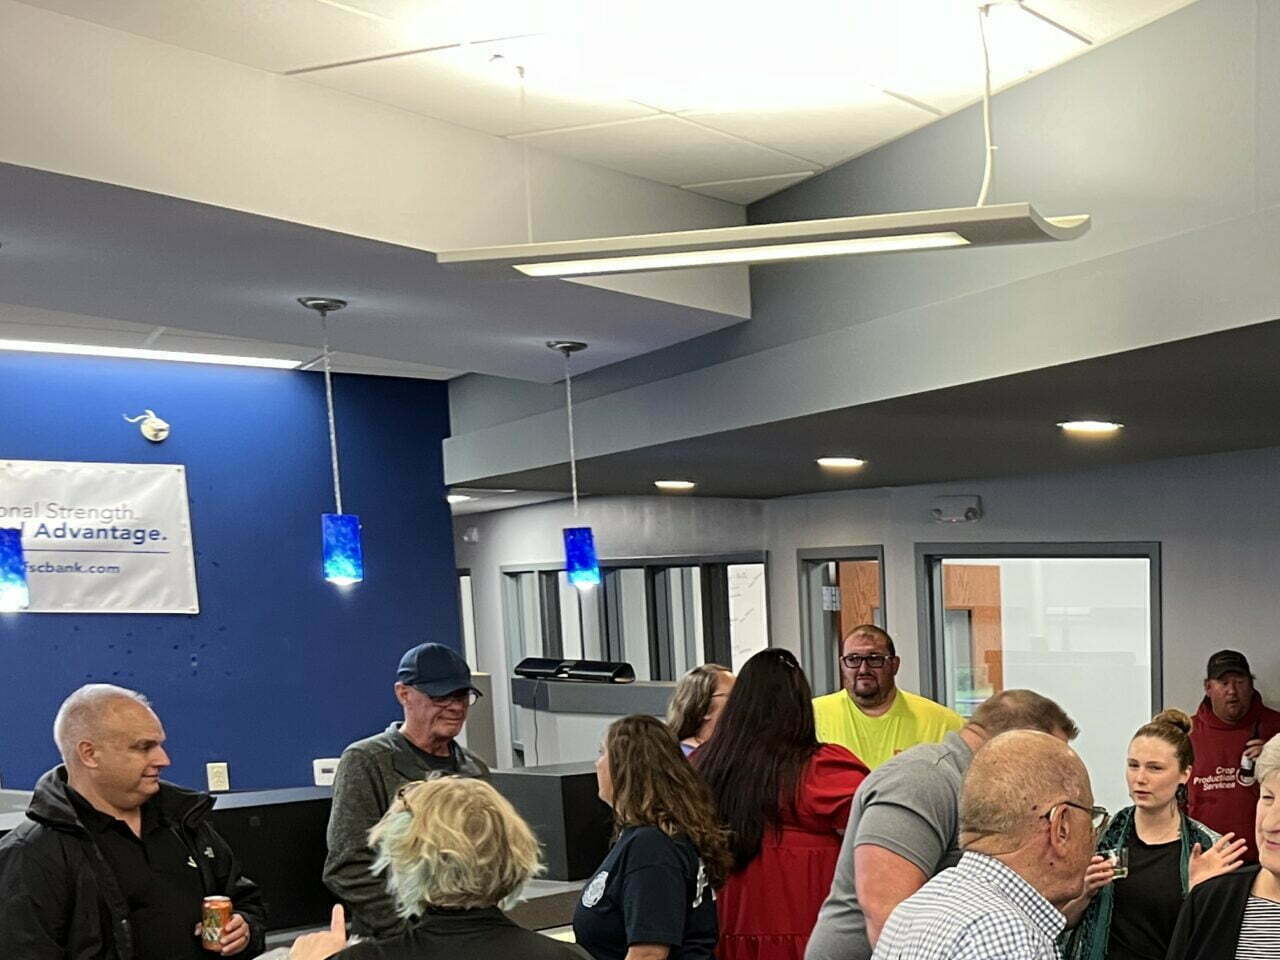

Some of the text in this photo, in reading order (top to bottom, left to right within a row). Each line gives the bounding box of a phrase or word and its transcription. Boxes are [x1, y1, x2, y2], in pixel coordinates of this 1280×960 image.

[34, 522, 168, 544] Advantage.
[1215, 766, 1235, 775] Crop
[1193, 774, 1235, 785] Production
